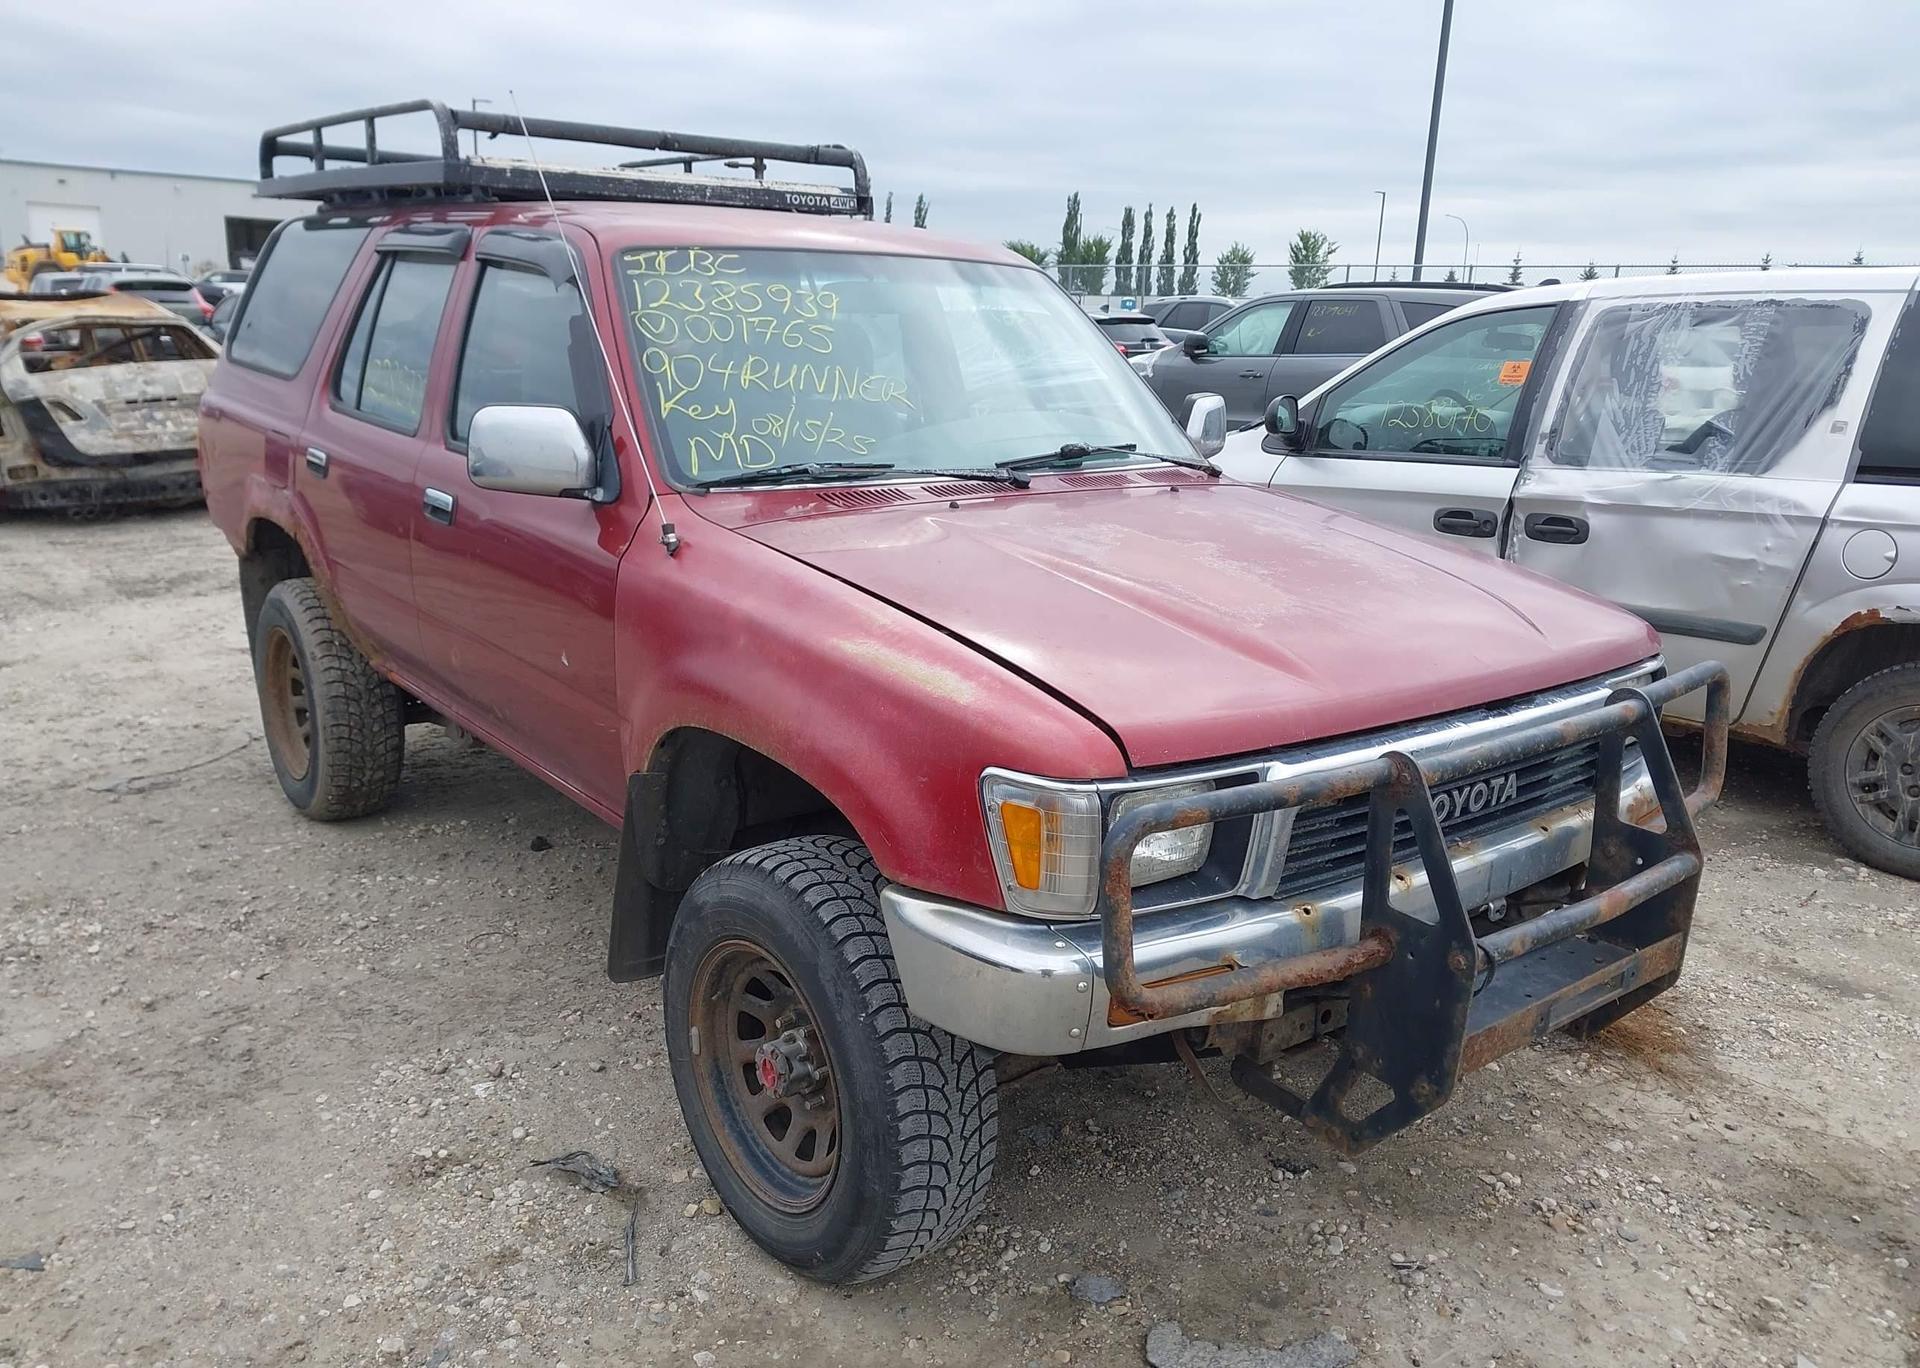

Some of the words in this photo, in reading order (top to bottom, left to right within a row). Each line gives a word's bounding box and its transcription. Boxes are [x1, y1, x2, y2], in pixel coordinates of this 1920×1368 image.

[785, 193, 829, 207] TOYOTA
[830, 196, 857, 208] 4WD
[632, 279, 840, 320] 12385939
[1433, 771, 1517, 822] OYOTA
